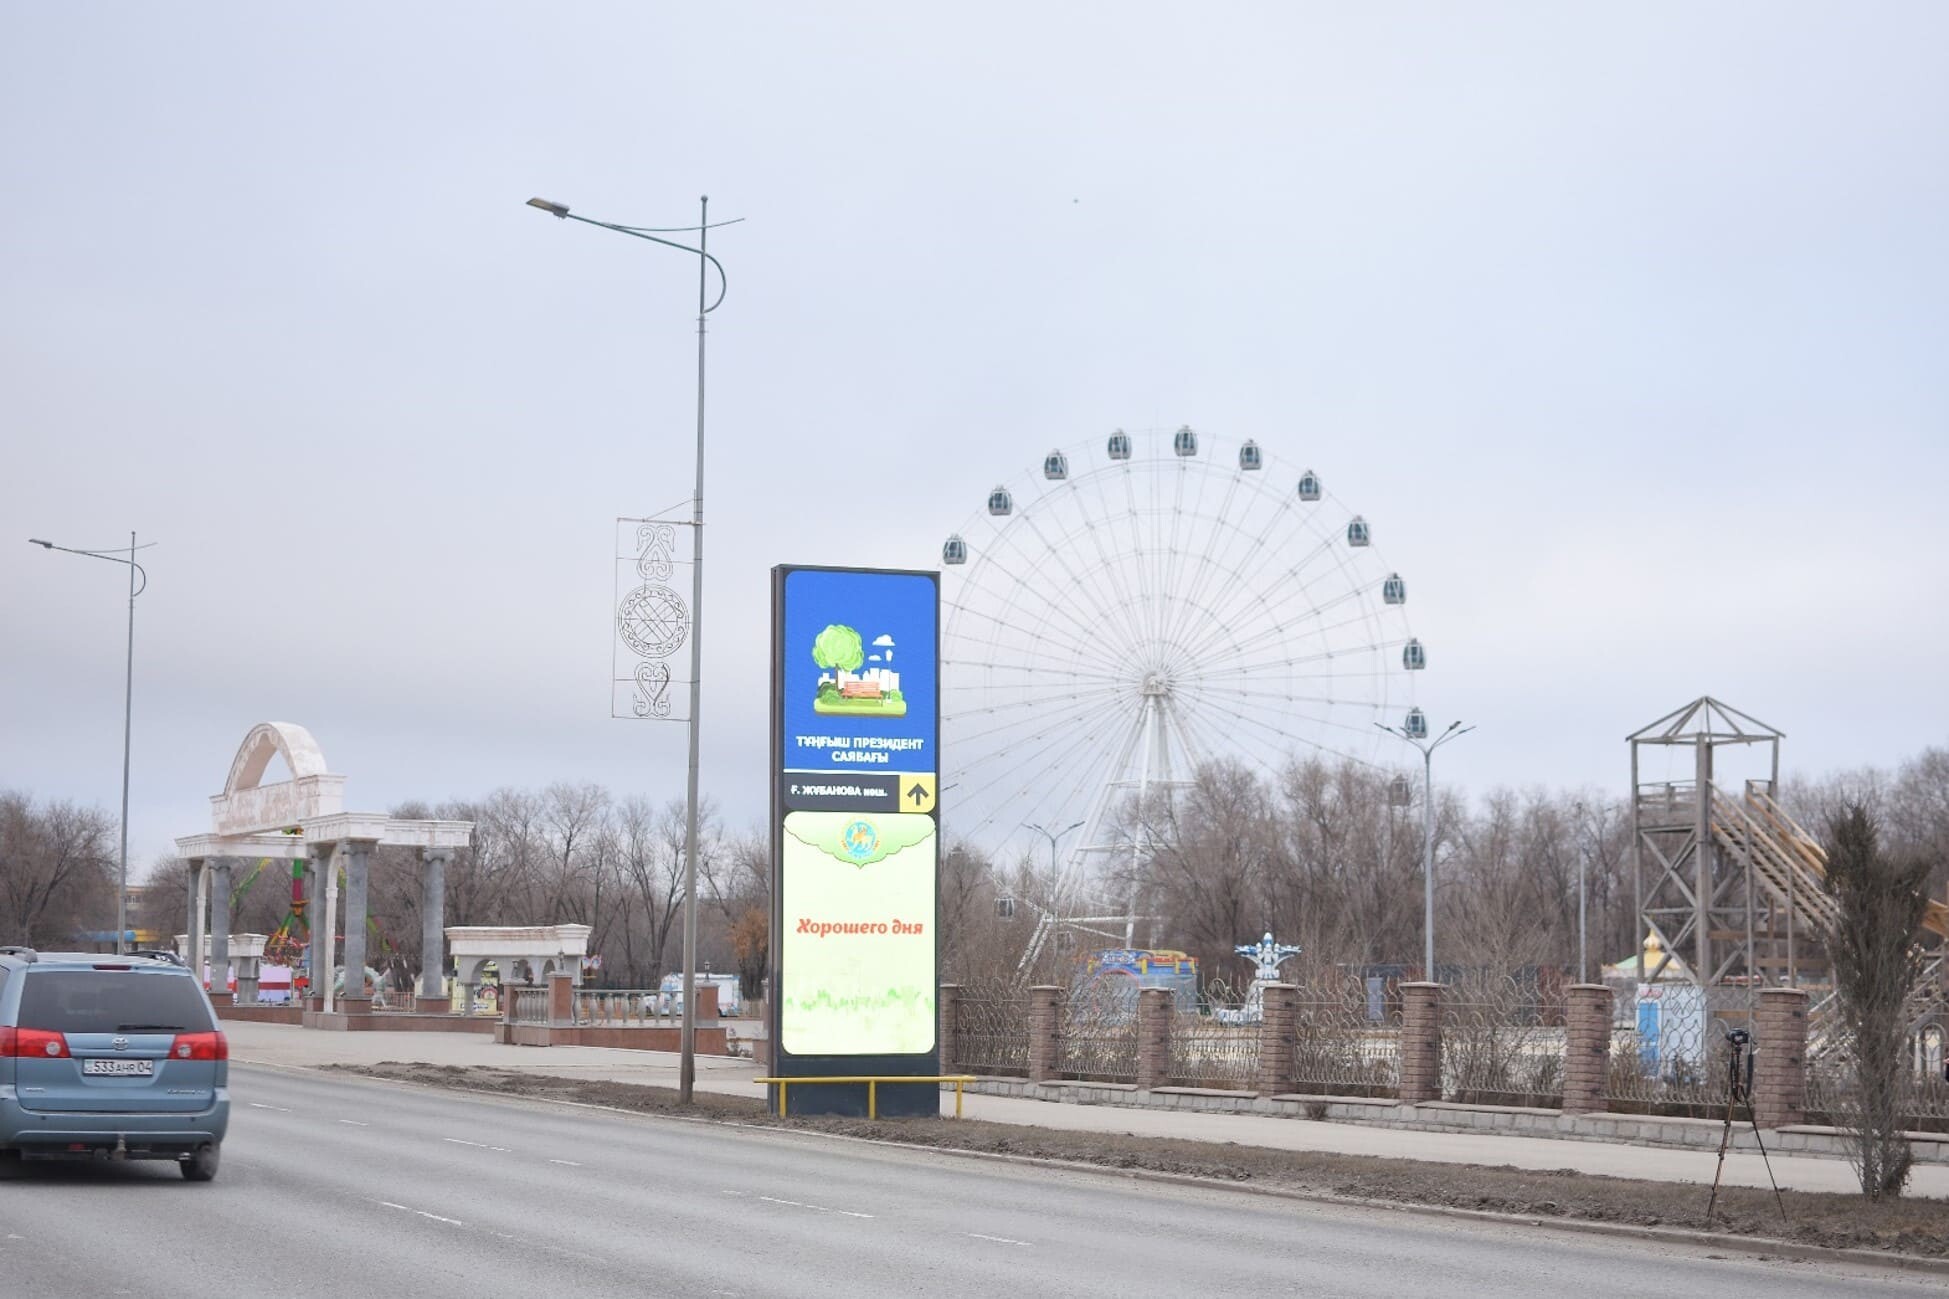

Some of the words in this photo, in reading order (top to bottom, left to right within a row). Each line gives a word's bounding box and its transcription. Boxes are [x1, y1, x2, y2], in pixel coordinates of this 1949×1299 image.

[854, 737, 924, 751] ПРЕЗИДЕНТ
[831, 751, 889, 763] САЯБАҒЫ
[796, 918, 888, 938] Хорошего
[891, 918, 924, 935] дня
